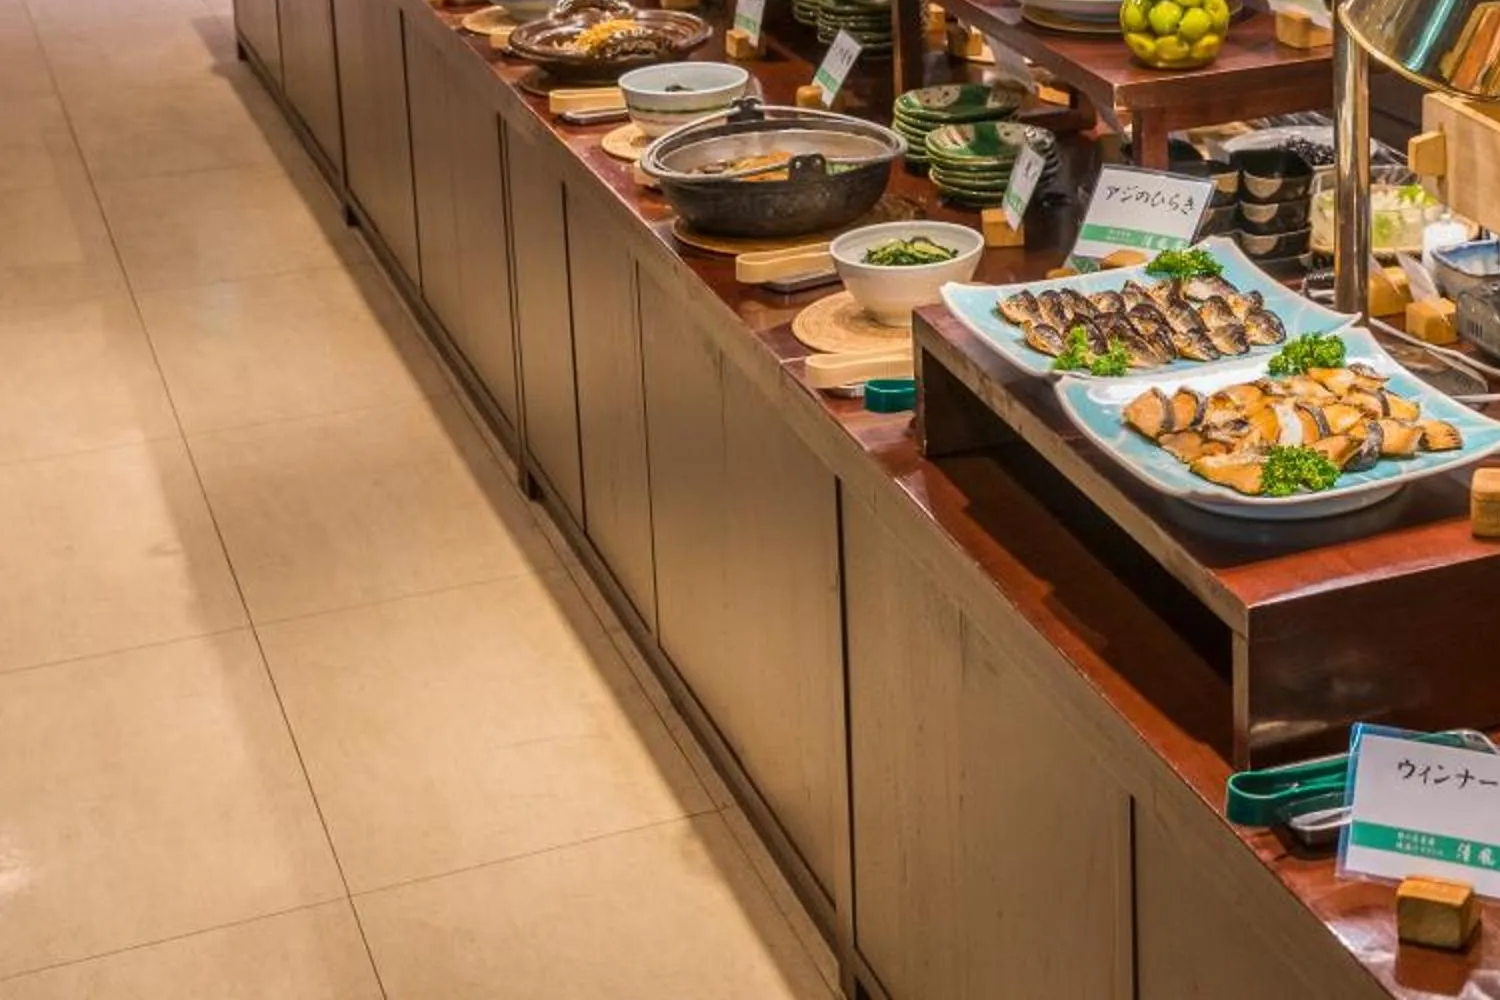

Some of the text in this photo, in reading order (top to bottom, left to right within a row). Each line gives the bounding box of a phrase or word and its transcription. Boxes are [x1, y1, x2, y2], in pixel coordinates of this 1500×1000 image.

[1105, 185, 1195, 216] アジのひらき
